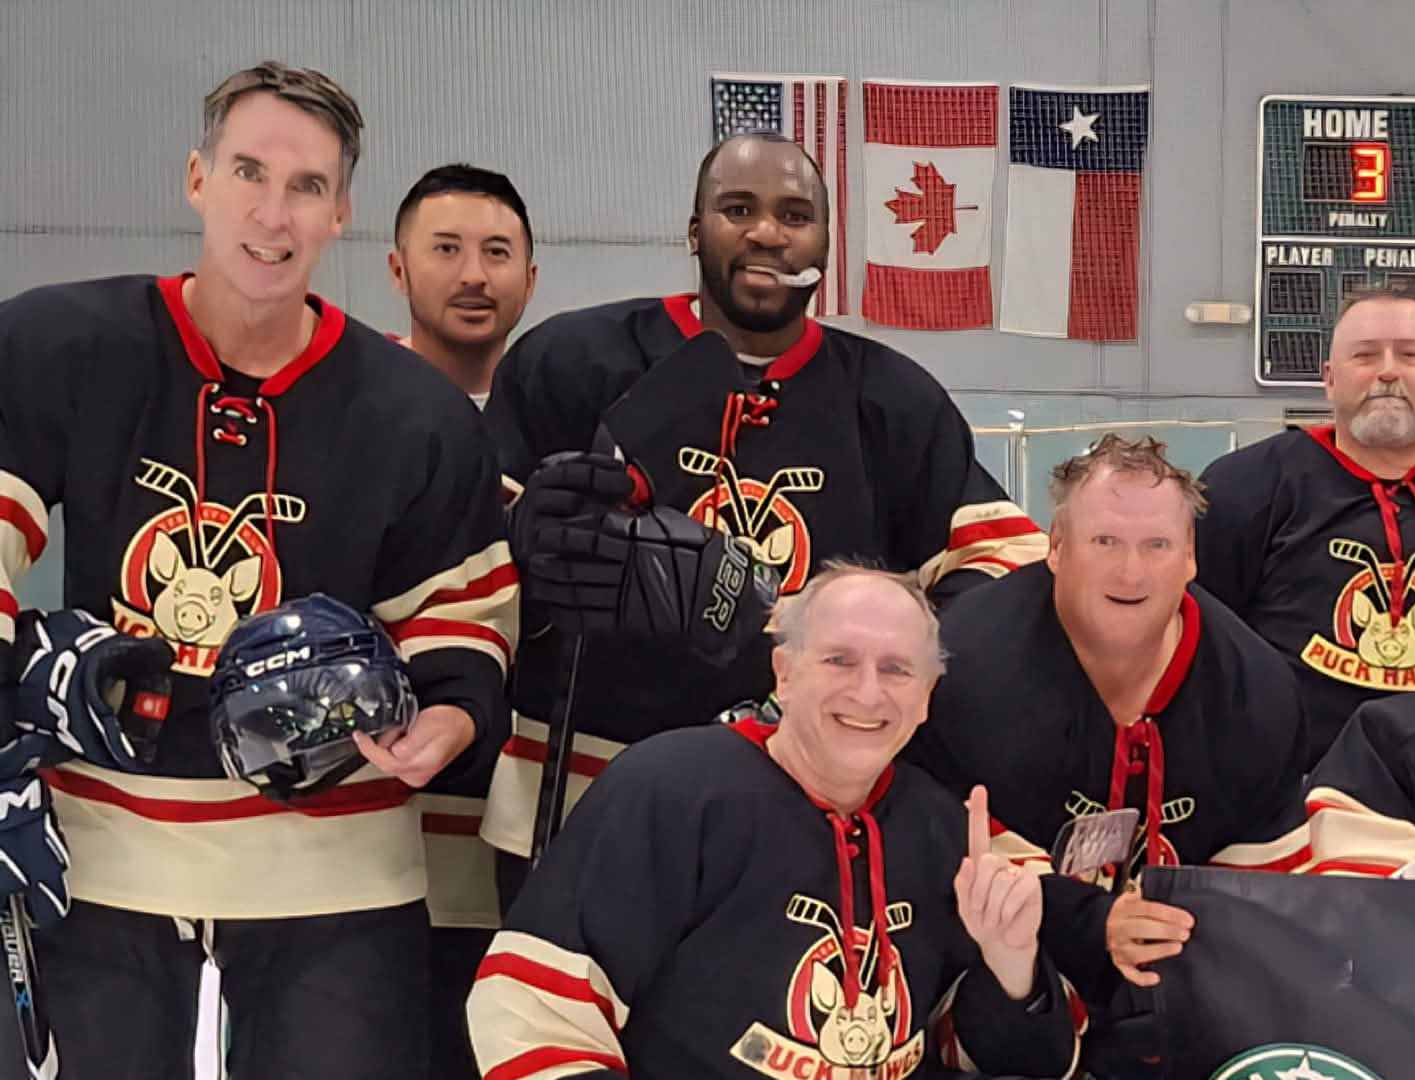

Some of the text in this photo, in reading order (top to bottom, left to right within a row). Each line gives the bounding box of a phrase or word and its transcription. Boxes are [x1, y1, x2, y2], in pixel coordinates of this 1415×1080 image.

[1303, 109, 1388, 139] HOME
[1352, 144, 1386, 200] 3
[1267, 247, 1333, 266] PLAYER
[245, 645, 311, 677] CCM
[1309, 642, 1371, 682] PUCK
